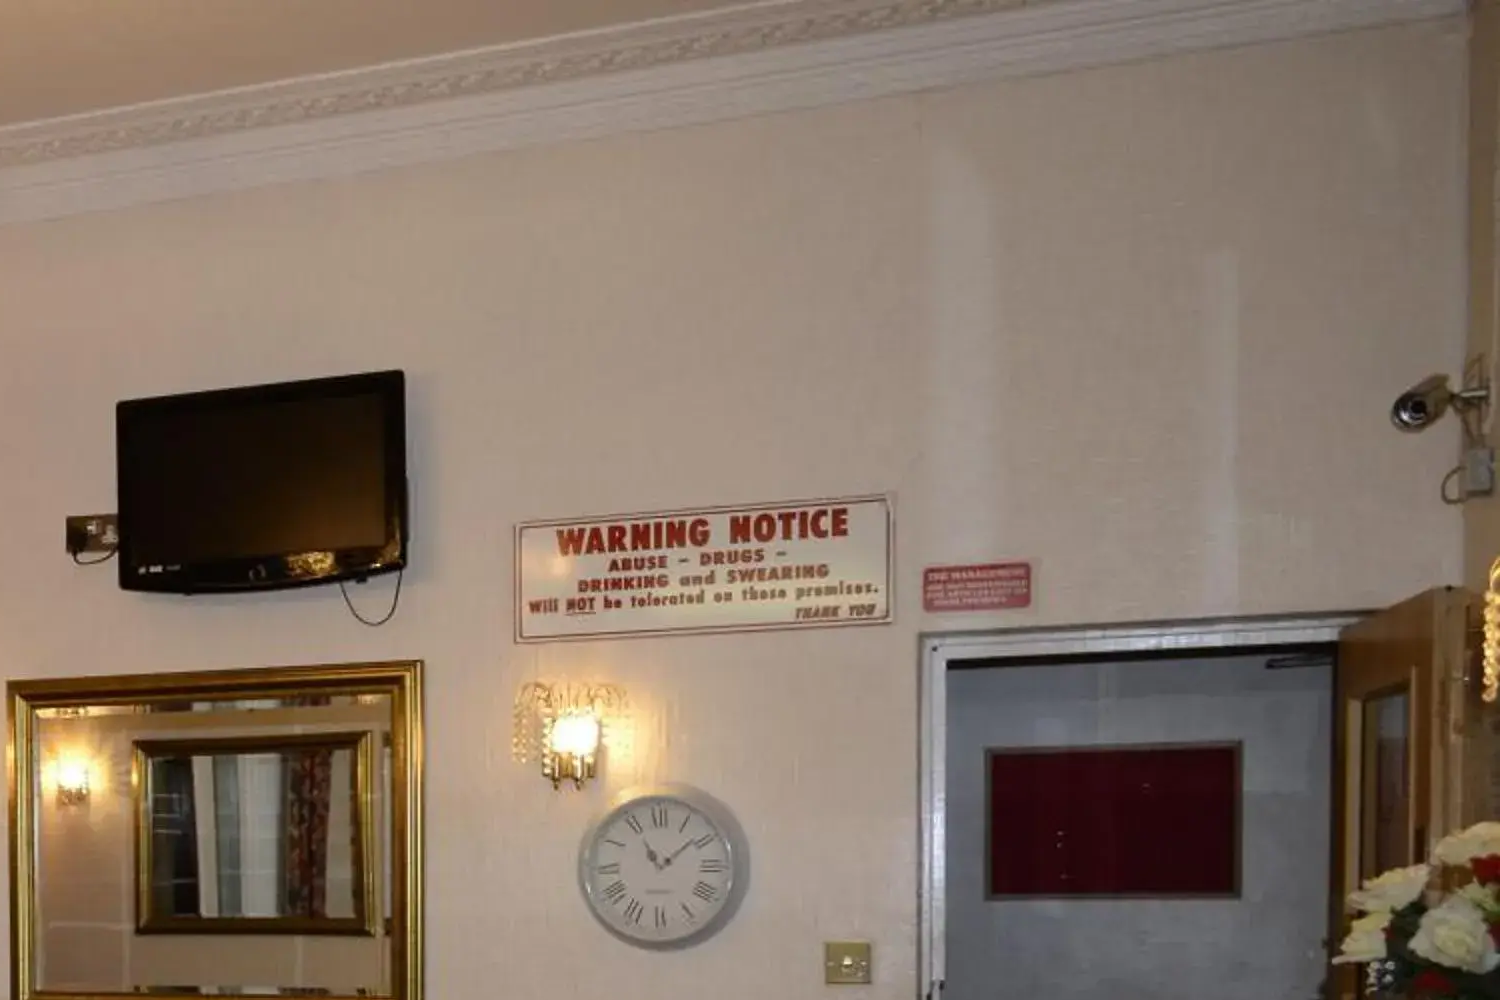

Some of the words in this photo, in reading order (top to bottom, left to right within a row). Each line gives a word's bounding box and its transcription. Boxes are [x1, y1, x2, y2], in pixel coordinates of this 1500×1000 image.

[556, 518, 710, 557] WARNING
[730, 508, 848, 544] NOTICE
[609, 556, 668, 572] ABUSE
[700, 549, 765, 566] DRUGS
[578, 574, 669, 592] DRINKING
[680, 570, 715, 587] and
[727, 564, 830, 584] SWEARING
[566, 597, 596, 611] NOT
[604, 595, 622, 608] be
[631, 589, 705, 608] tolerated
[714, 591, 732, 603] on
[796, 580, 878, 600] premises.
[796, 605, 840, 618] THANK
[847, 603, 876, 616] YOU
